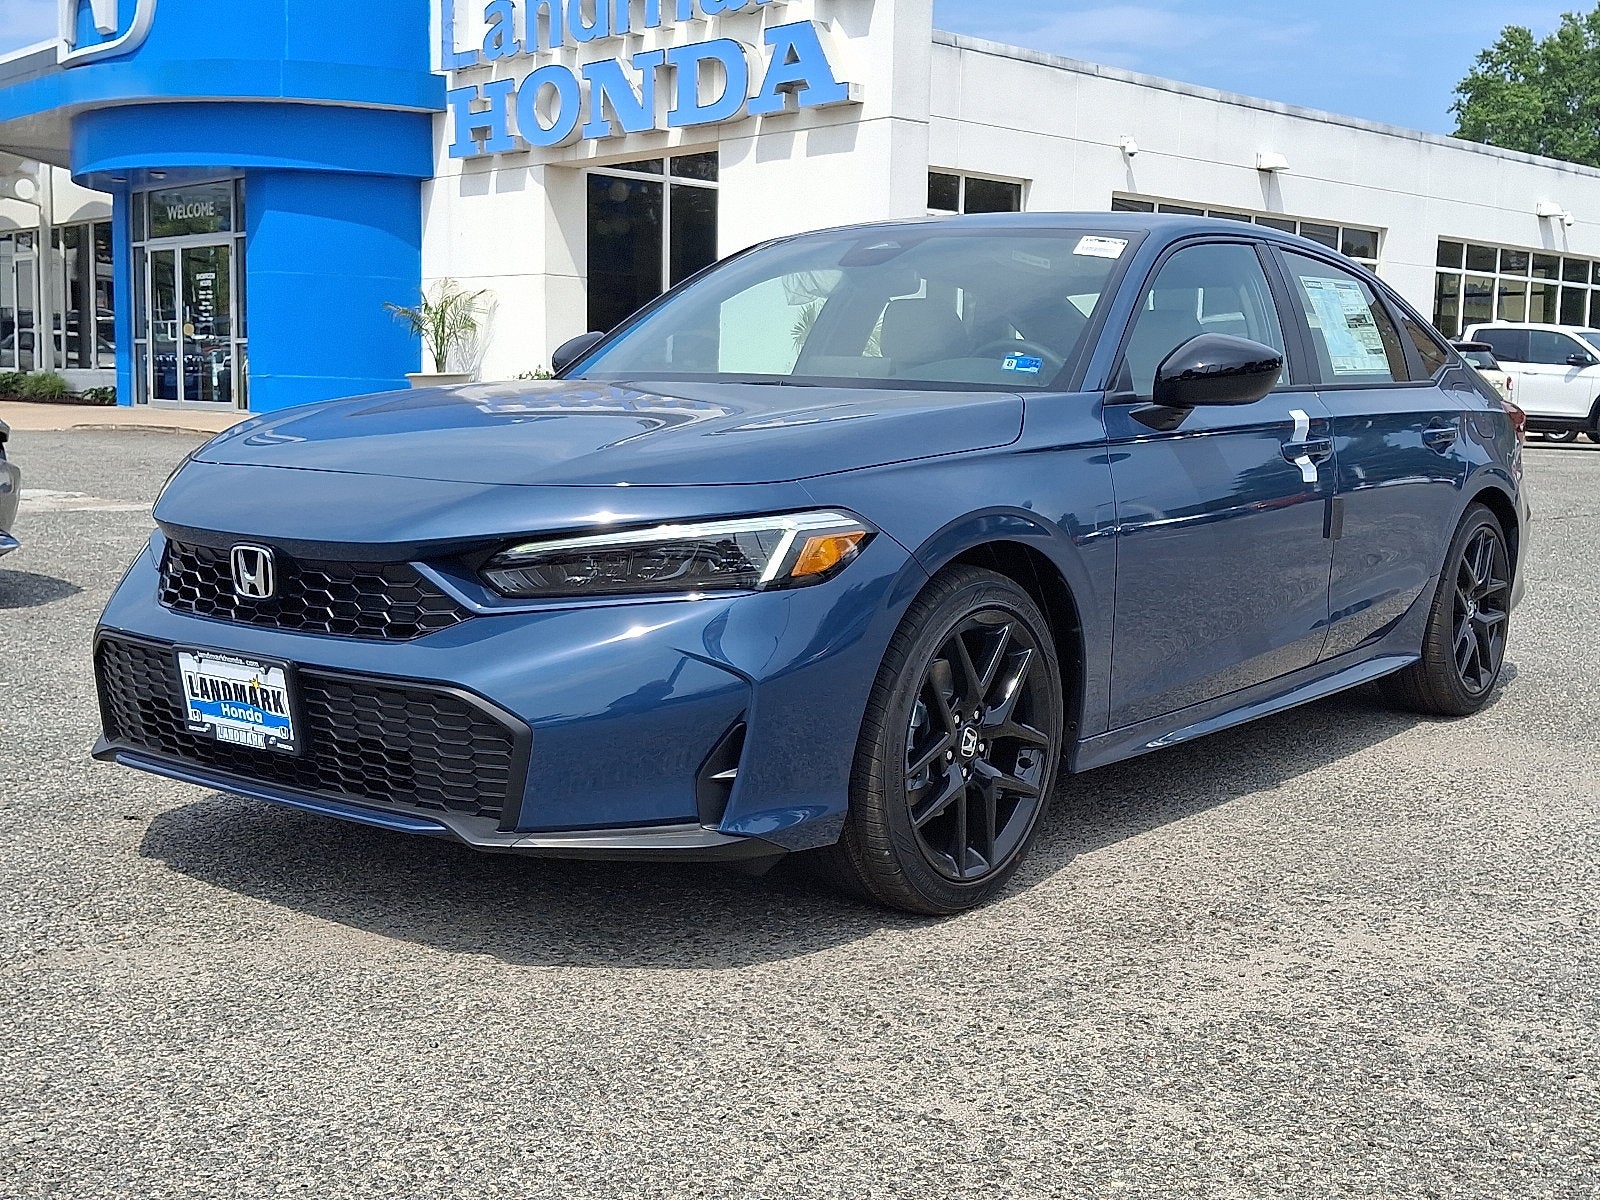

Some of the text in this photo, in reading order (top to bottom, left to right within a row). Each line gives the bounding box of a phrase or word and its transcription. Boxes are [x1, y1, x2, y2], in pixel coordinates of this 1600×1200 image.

[448, 20, 860, 158] HONDA
[167, 201, 215, 221] WELCOME
[187, 674, 286, 715] LANDMARK
[220, 702, 264, 724] Honda
[217, 724, 266, 748] LANDMARK
